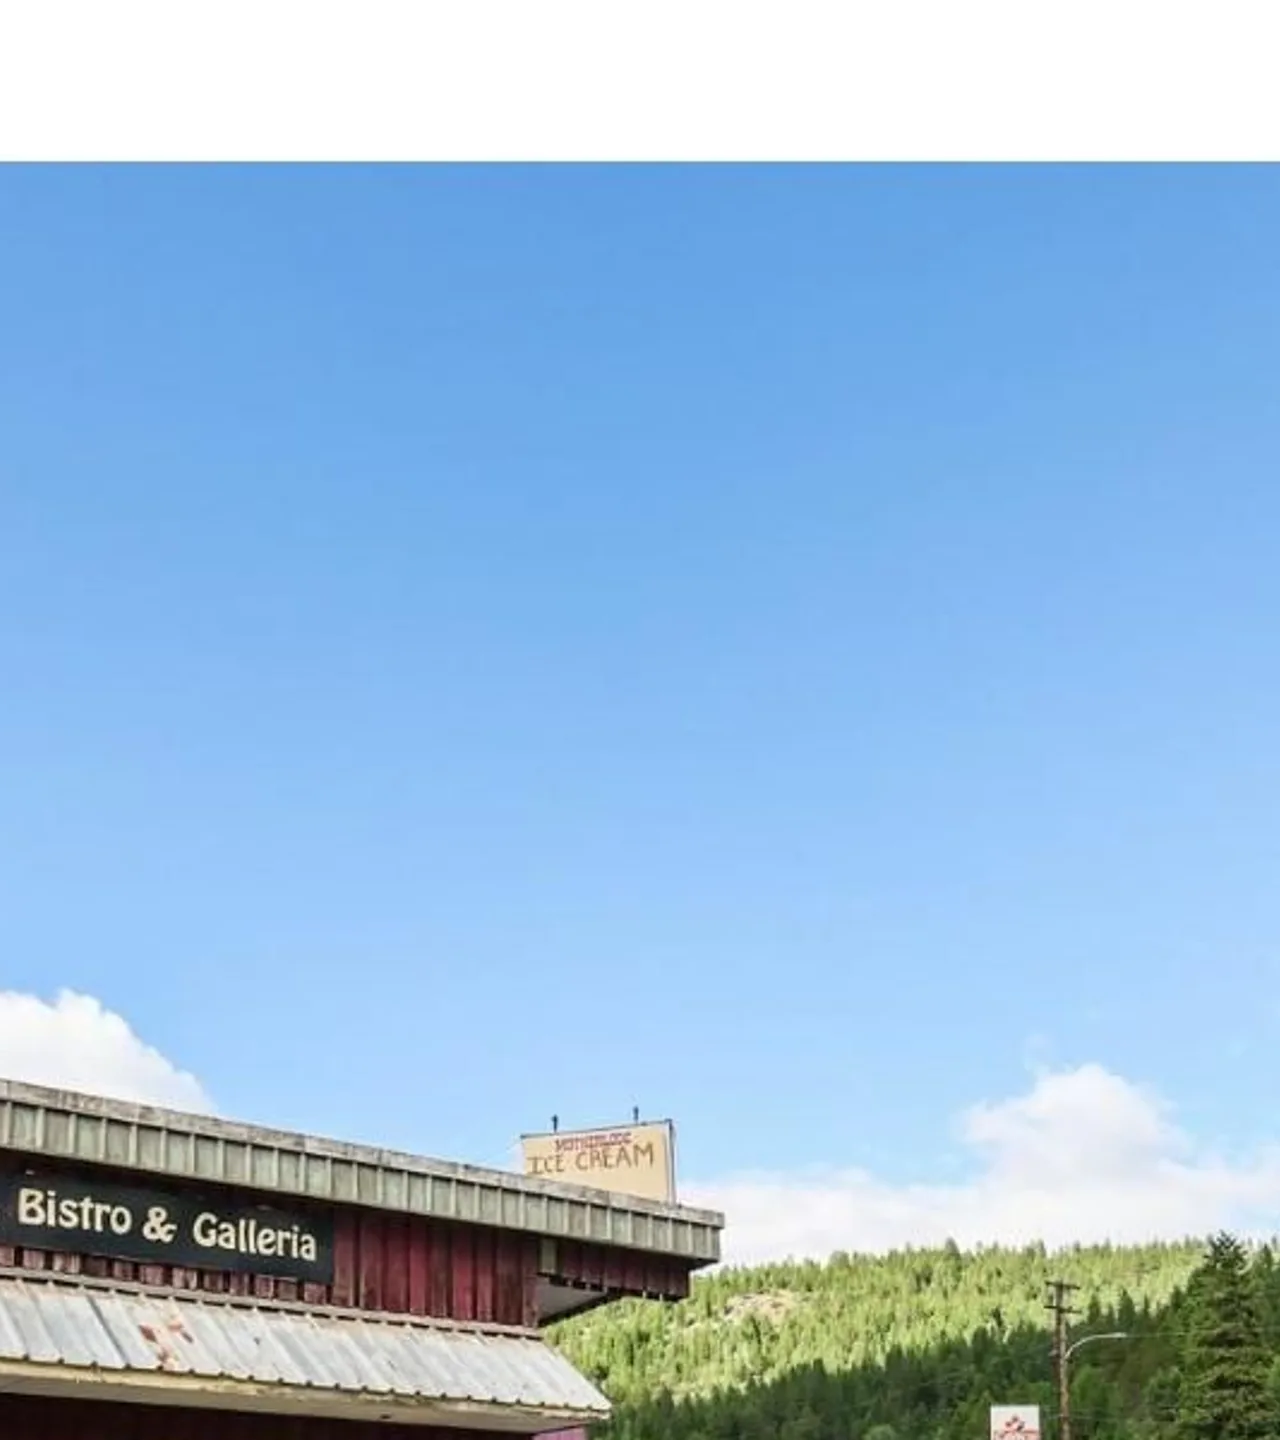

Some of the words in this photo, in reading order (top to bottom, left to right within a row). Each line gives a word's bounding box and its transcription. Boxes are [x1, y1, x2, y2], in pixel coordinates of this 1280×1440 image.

[527, 1154, 565, 1175] ICE
[575, 1141, 654, 1171] CREAM
[17, 1187, 132, 1235] Bistro
[142, 1206, 177, 1243] &
[193, 1211, 318, 1262] Galleria
